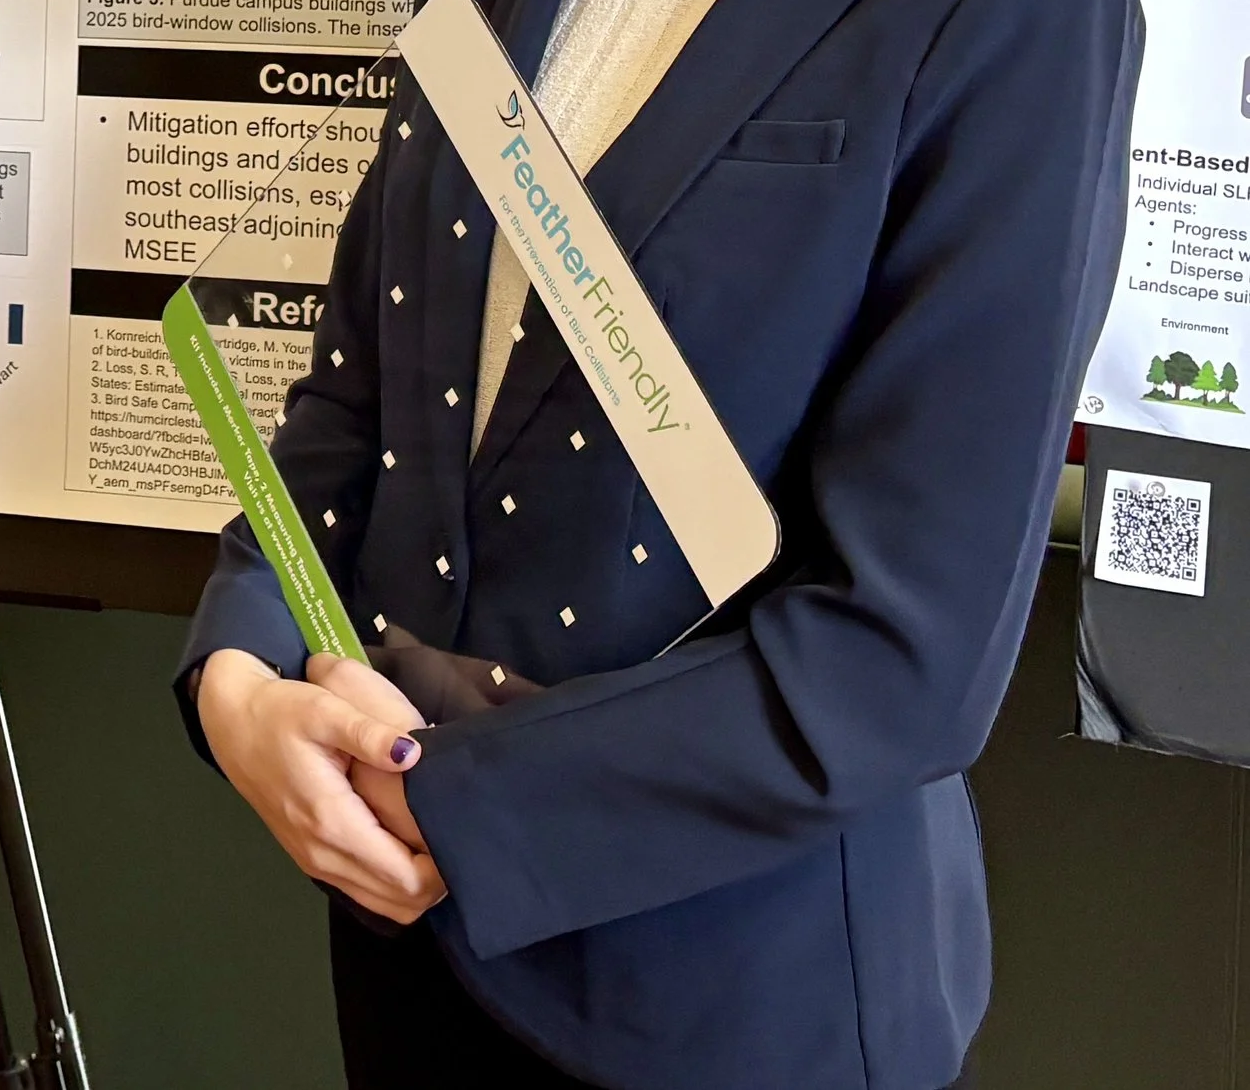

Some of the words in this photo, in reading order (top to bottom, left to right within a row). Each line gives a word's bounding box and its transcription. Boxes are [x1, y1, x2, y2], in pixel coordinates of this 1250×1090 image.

[128, 111, 237, 138] Mitigation
[246, 116, 317, 139] efforts
[1138, 174, 1217, 197] Individual
[1135, 195, 1197, 215] Agents:
[1173, 219, 1248, 241] Progress
[125, 238, 197, 263] MSEE
[1172, 239, 1234, 261] Interact
[498, 194, 514, 215] For
[561, 304, 573, 318] of
[568, 318, 587, 345] Bird
[1170, 260, 1244, 282] Disperse
[1128, 275, 1219, 302] Landscape
[1161, 317, 1229, 336] Environment
[287, 360, 307, 372] the
